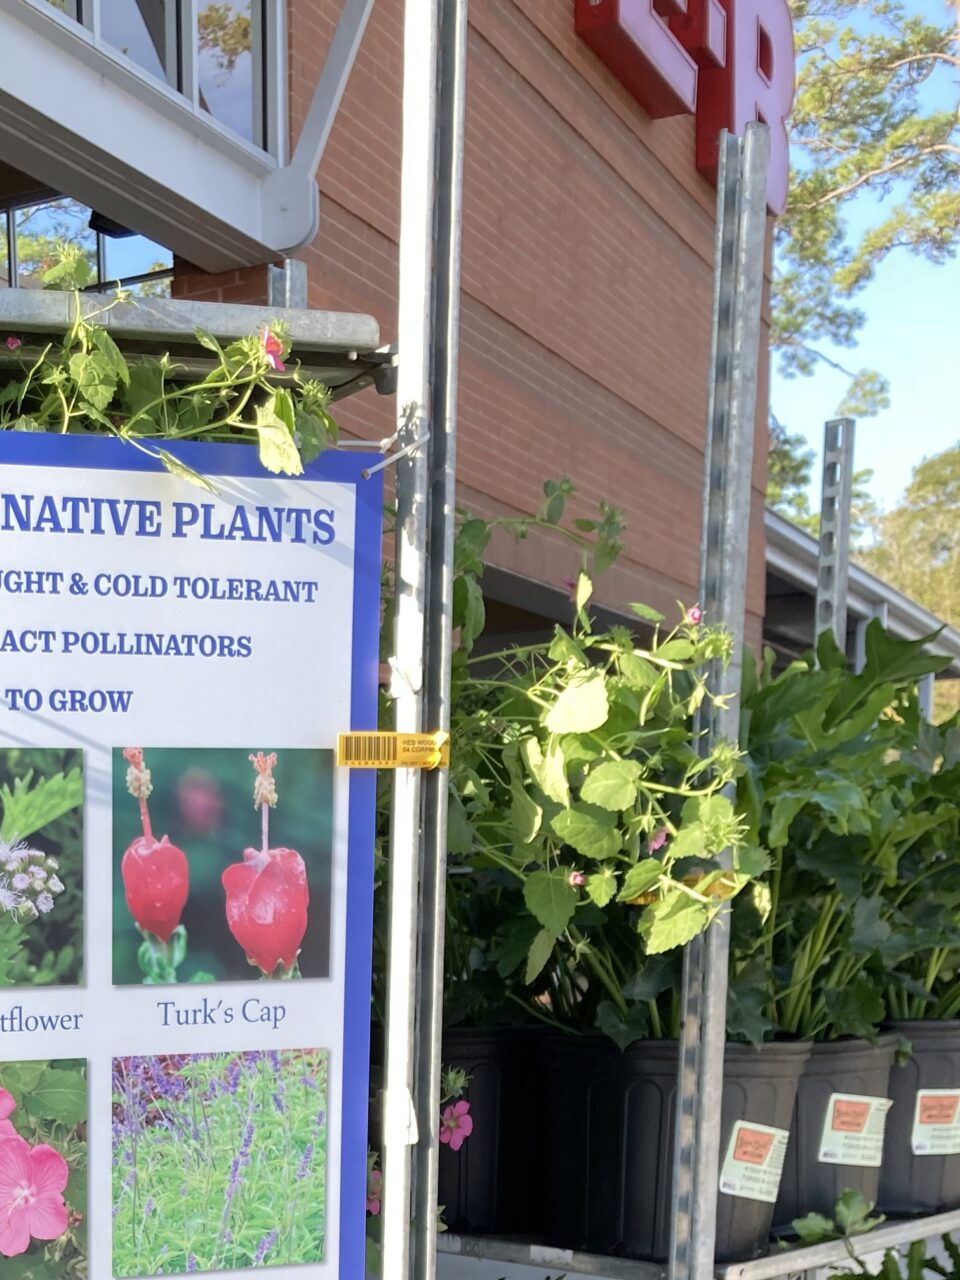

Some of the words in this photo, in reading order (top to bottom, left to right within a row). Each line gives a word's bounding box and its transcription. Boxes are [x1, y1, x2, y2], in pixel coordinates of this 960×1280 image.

[1, 493, 162, 537] NATIVE
[172, 502, 335, 545] PLANTS
[69, 572, 89, 596] &
[94, 573, 168, 597] COLD
[173, 576, 319, 603] TOLERANT
[62, 631, 252, 658] POLLINATORS
[5, 688, 43, 711] TO
[49, 689, 134, 712] GROW
[157, 998, 234, 1026] Turk's
[242, 998, 286, 1029] Cap
